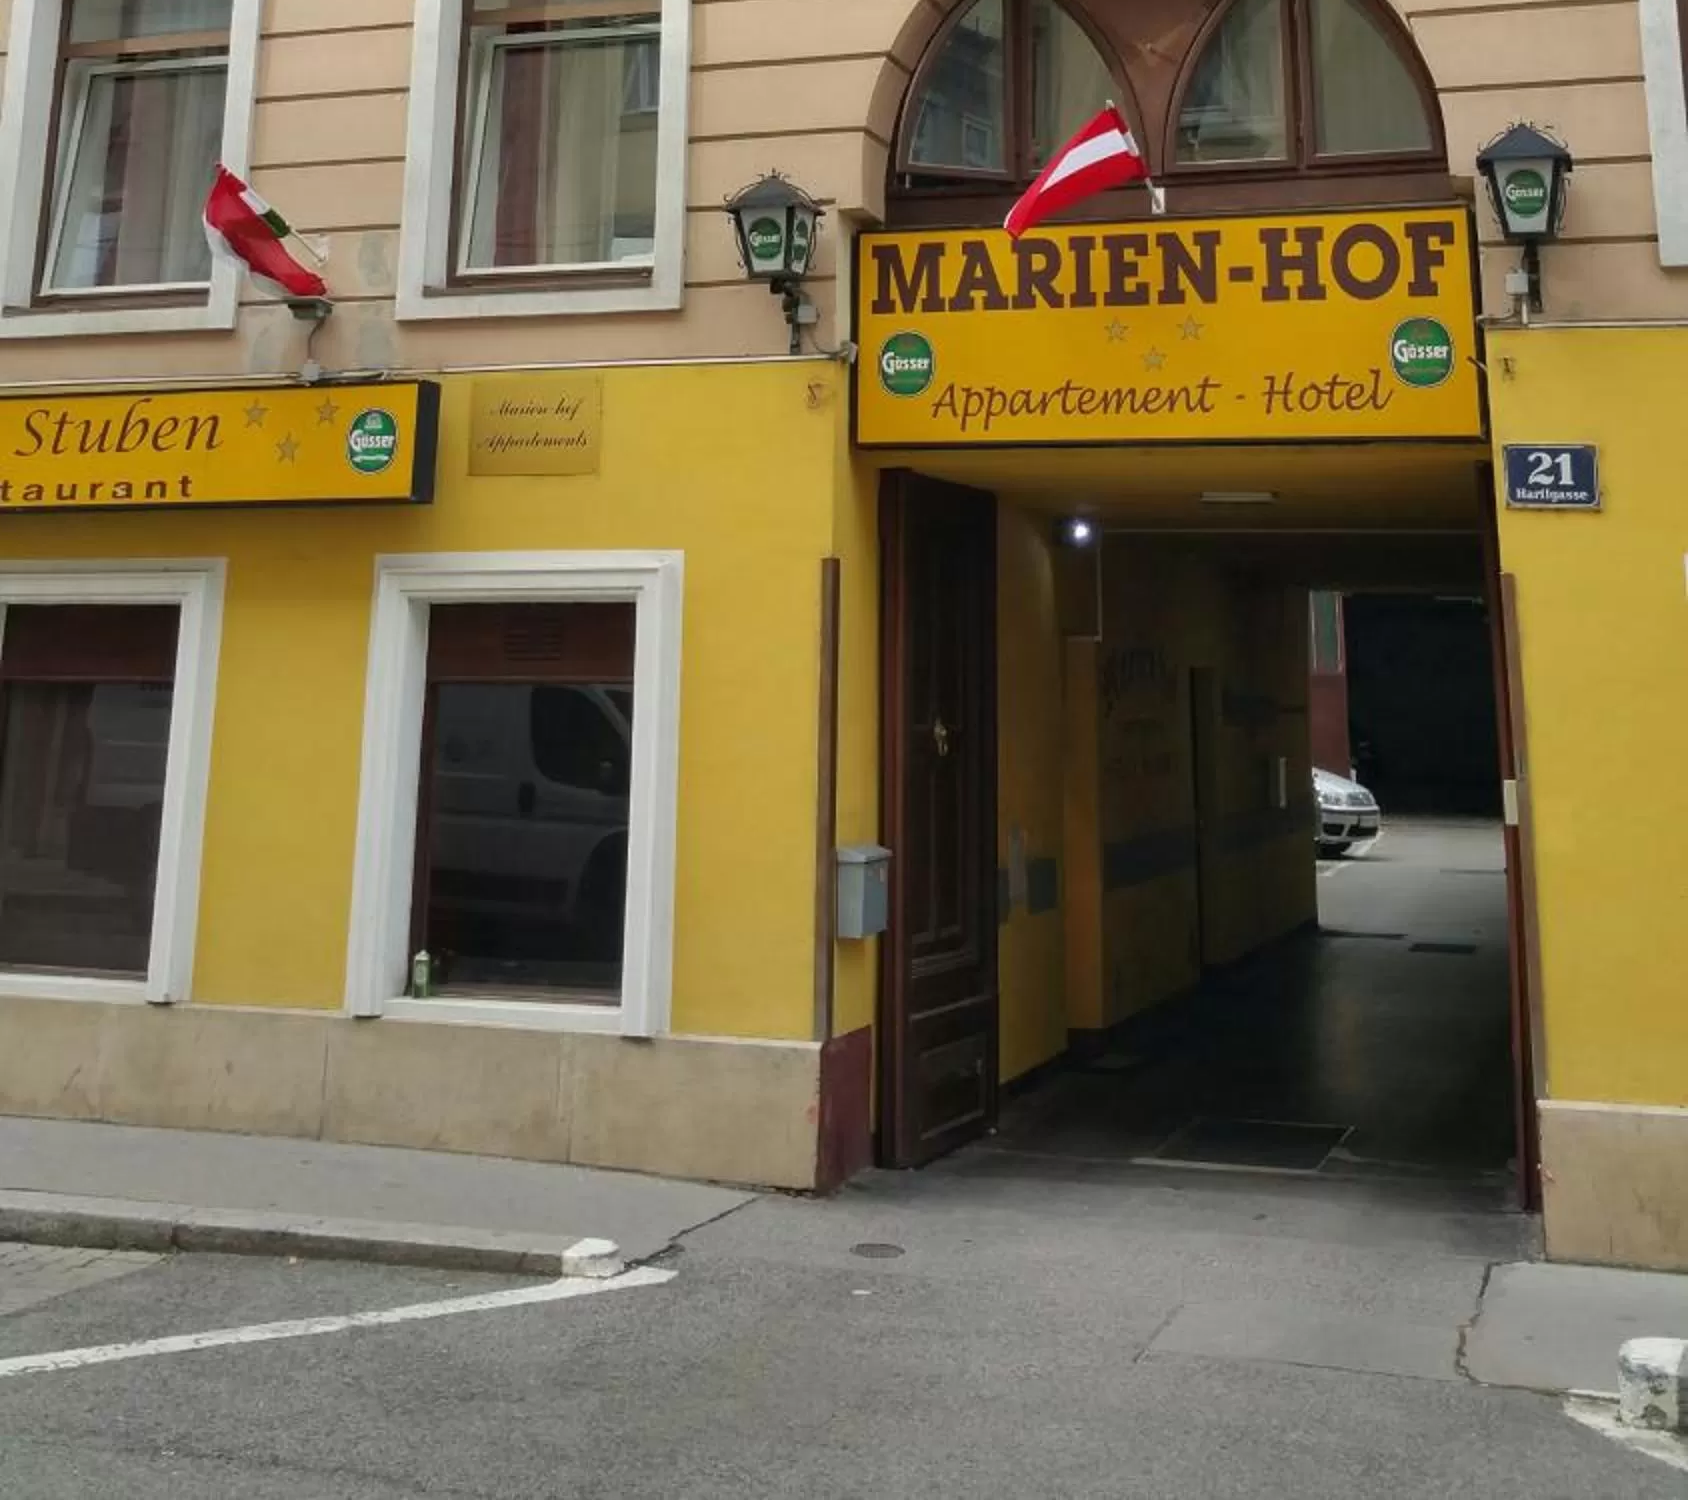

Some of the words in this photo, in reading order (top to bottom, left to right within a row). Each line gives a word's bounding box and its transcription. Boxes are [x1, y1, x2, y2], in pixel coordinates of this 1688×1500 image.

[871, 220, 1455, 315] MARIEN-HOF
[13, 397, 225, 457] Stuben
[931, 377, 1223, 432] Appartement
[1262, 368, 1394, 415] Hotel
[1527, 451, 1575, 486] 21
